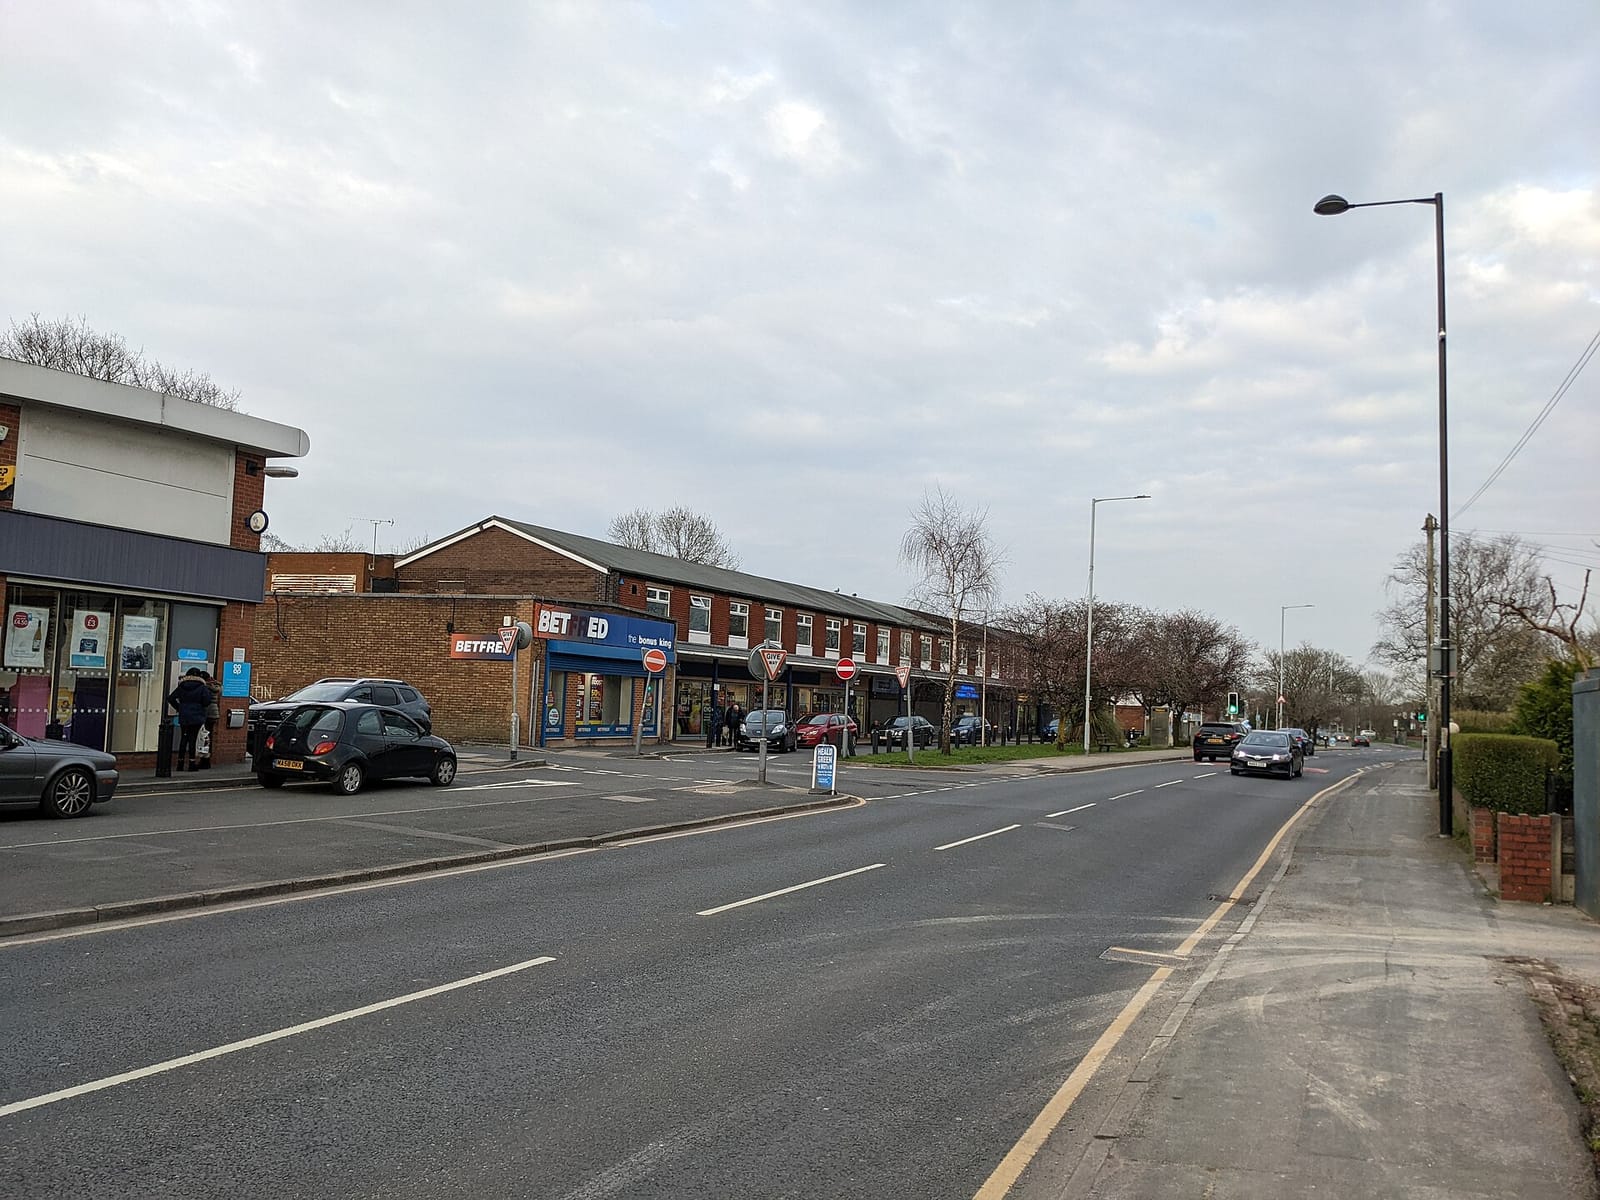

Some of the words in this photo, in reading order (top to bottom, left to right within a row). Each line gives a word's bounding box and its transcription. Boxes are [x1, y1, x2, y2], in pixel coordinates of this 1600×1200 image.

[455, 640, 506, 654] BETFRE
[628, 634, 637, 644] the
[638, 634, 658, 646] bonus
[659, 637, 672, 650] king
[818, 747, 833, 756] HEALD
[818, 755, 833, 764] GREEN
